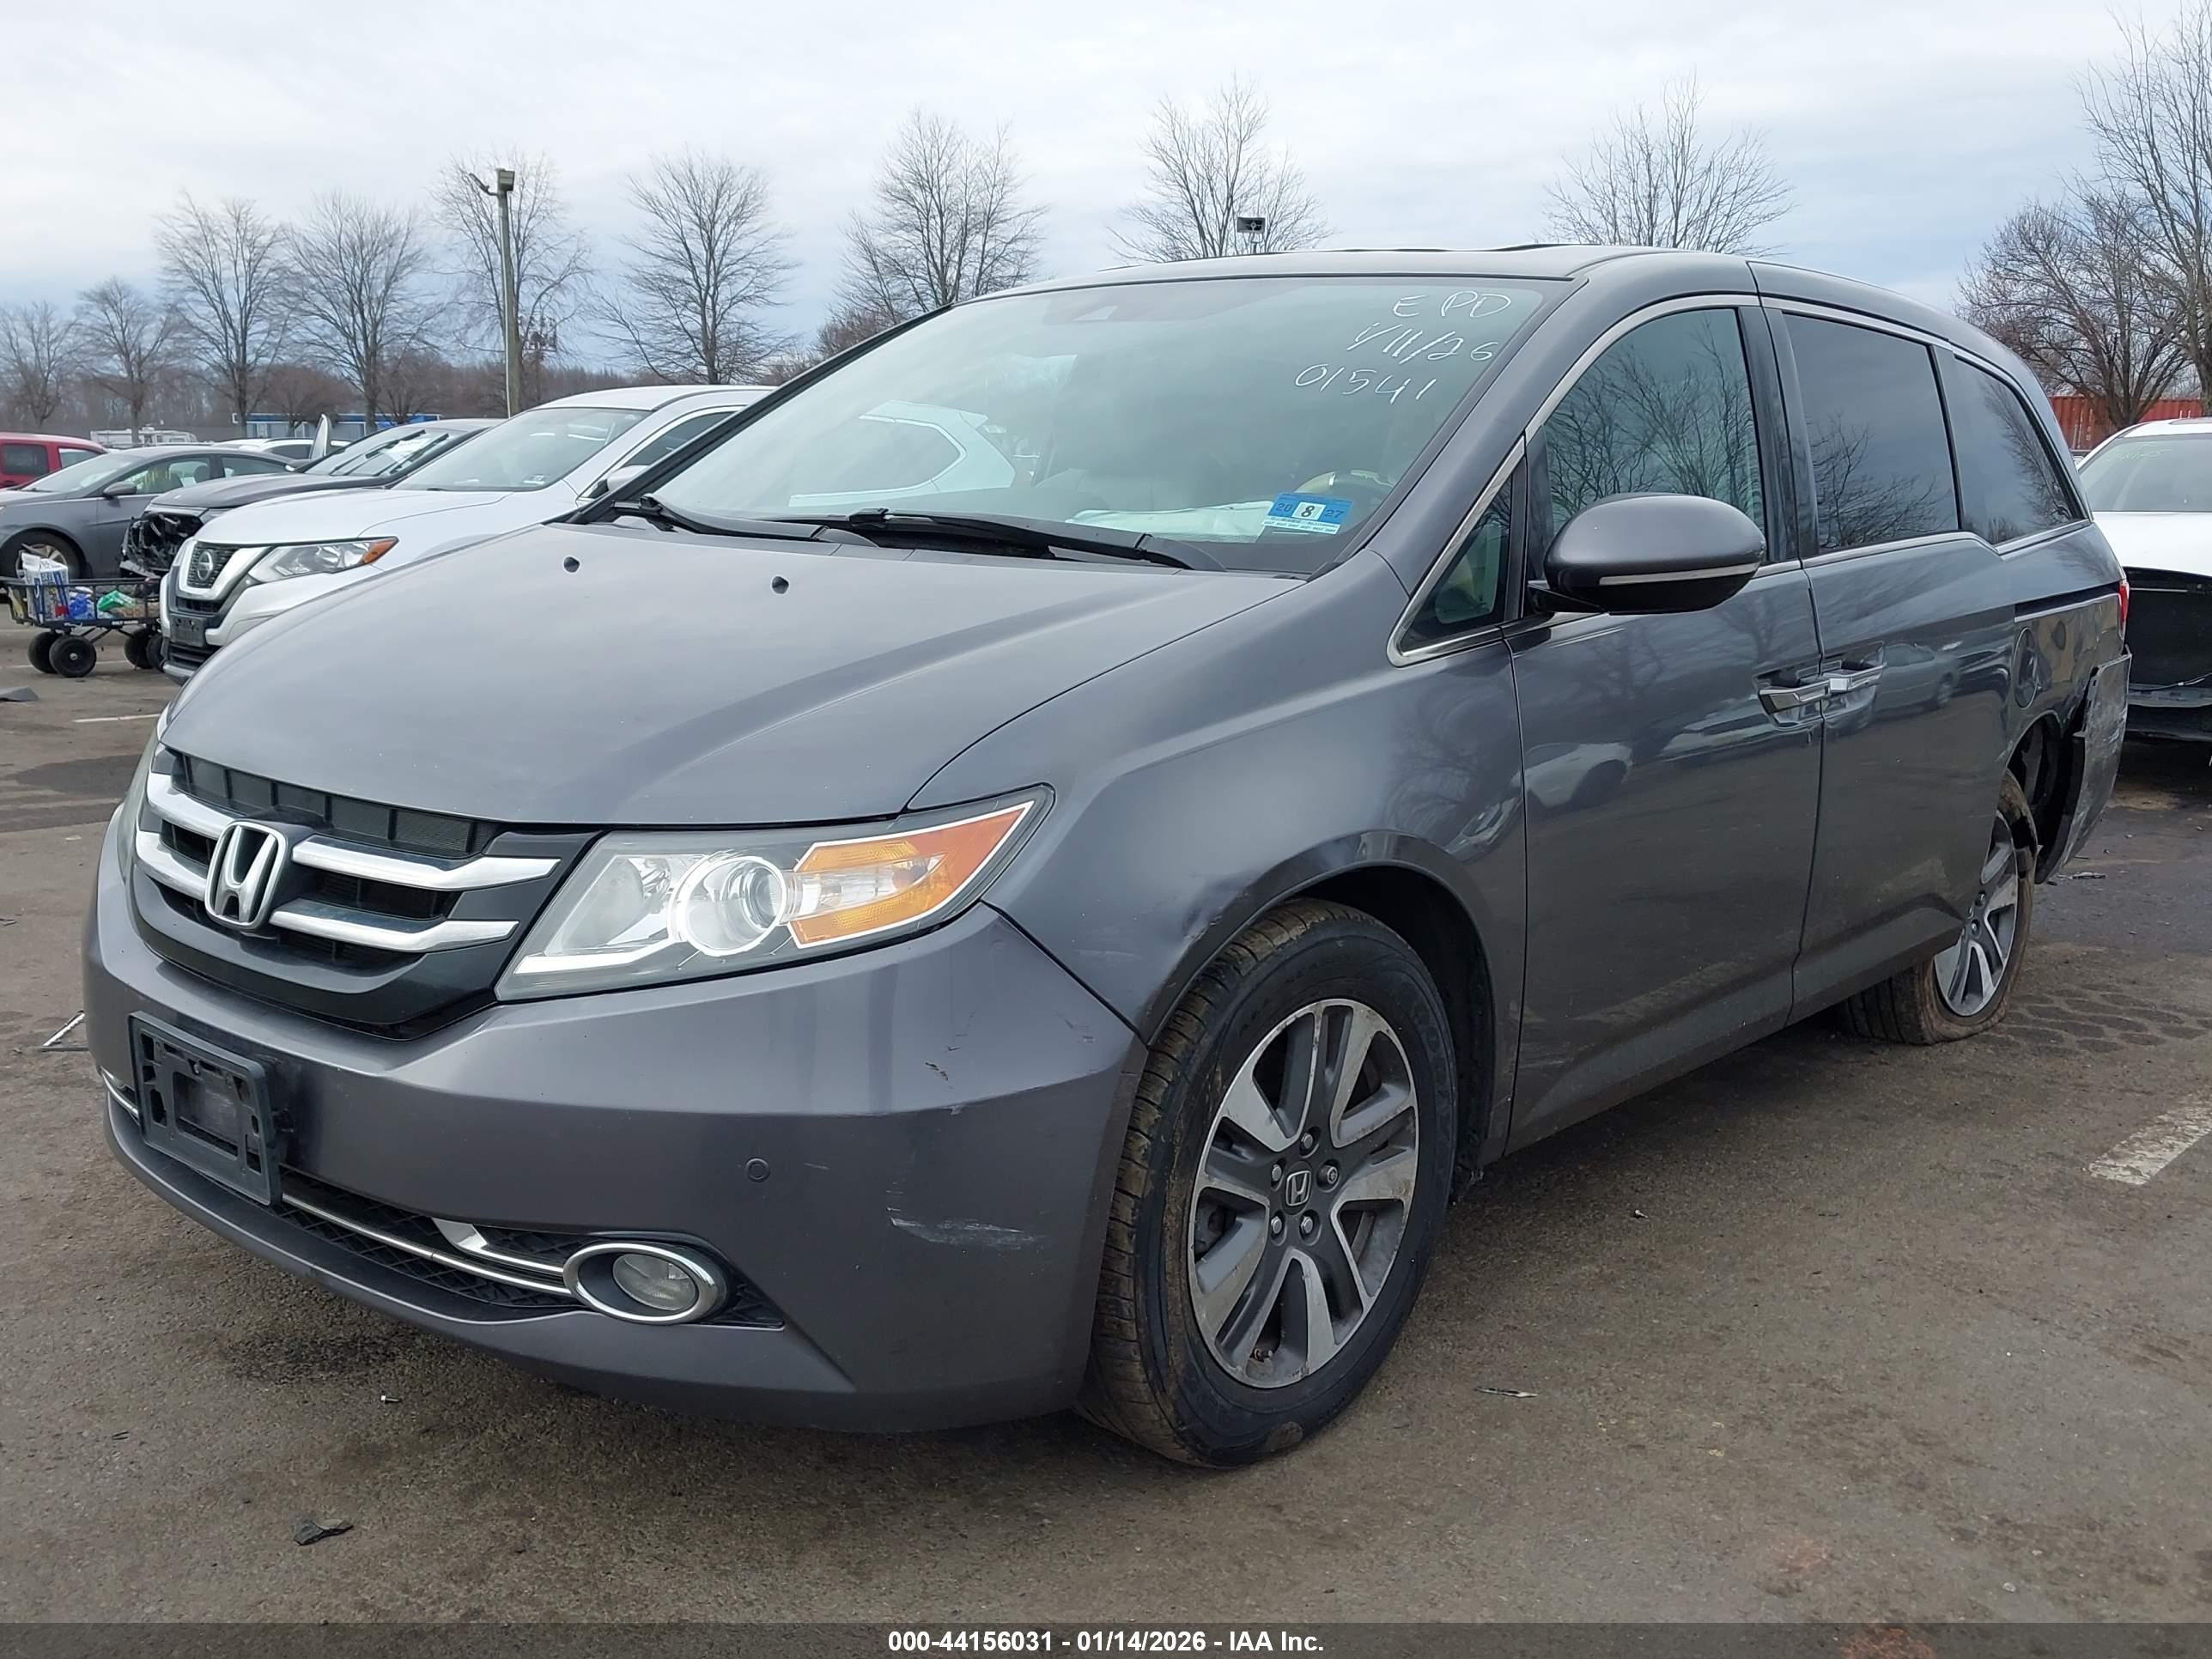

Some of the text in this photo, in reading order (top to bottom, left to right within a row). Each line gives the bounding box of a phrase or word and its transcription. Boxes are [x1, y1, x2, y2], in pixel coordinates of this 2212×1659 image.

[1295, 363, 1437, 404] 01541
[1275, 502, 1345, 519] 20 8 27
